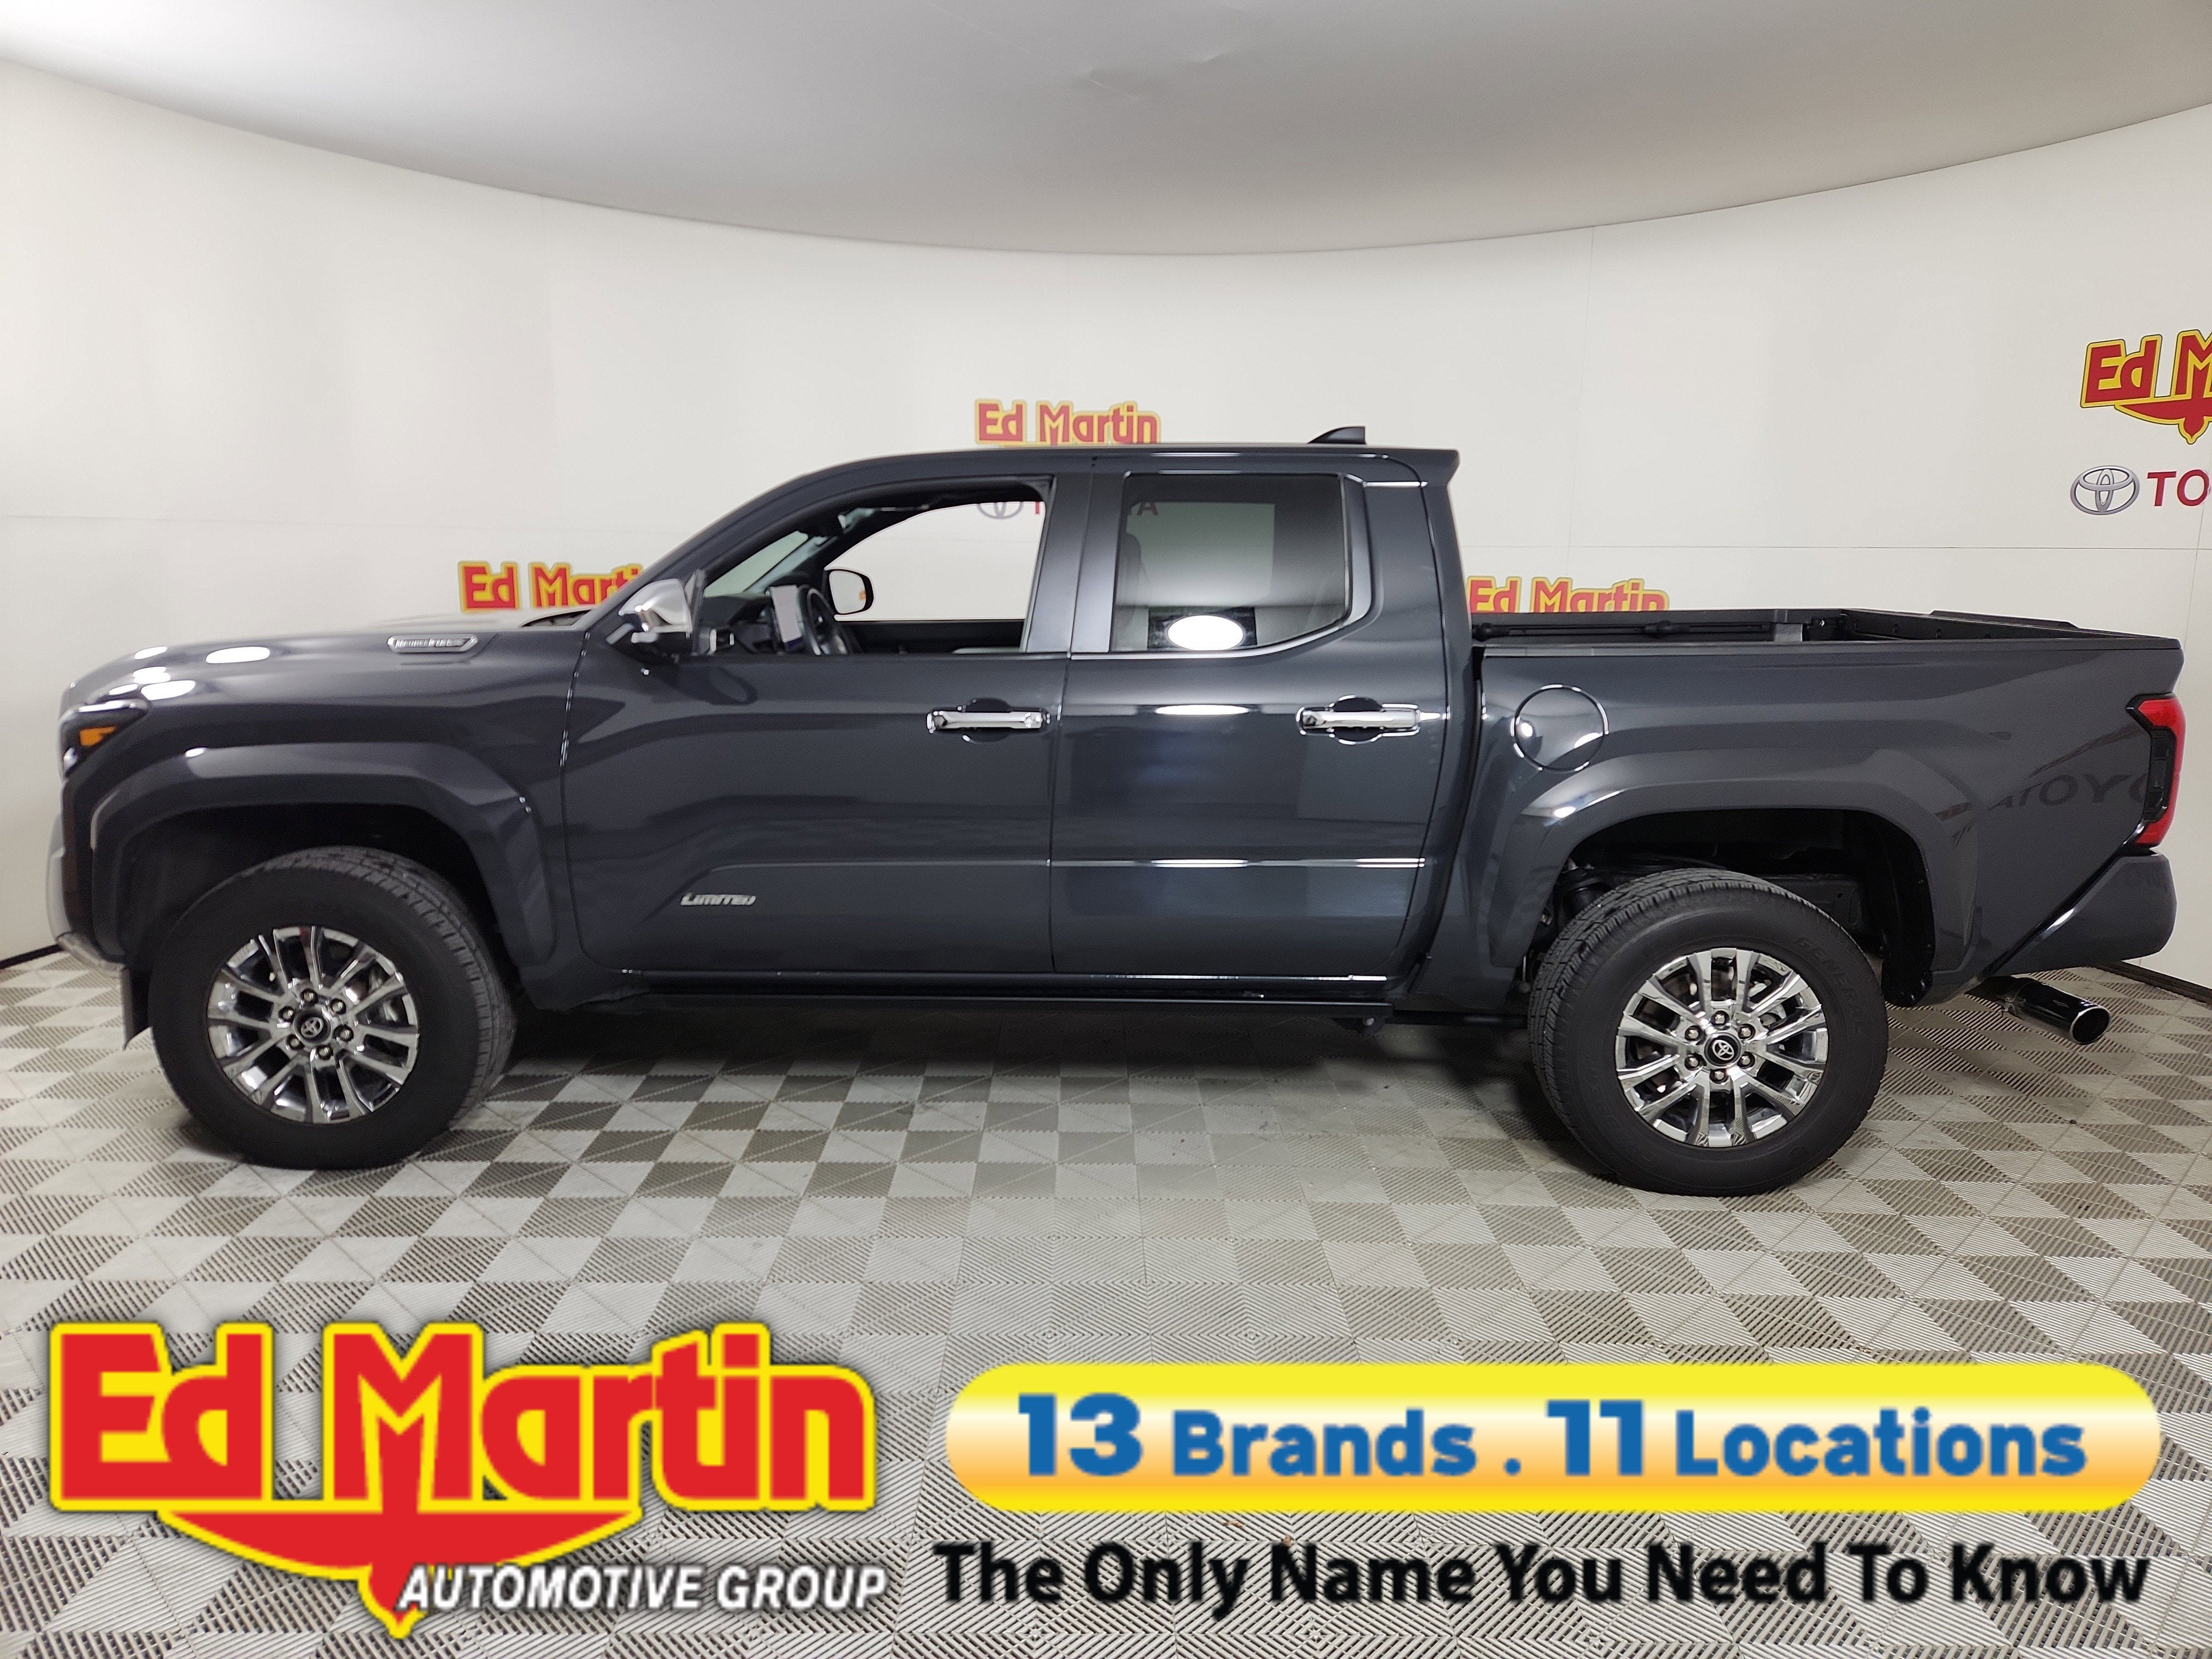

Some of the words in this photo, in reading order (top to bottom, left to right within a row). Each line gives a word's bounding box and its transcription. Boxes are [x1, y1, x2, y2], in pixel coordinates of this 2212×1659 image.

[2081, 334, 2162, 408] Ed
[976, 400, 1026, 443] Ed
[1037, 401, 1160, 443] Martin
[458, 562, 519, 612] Ed
[1468, 576, 1521, 613] Ed
[1531, 577, 1669, 613] Martin
